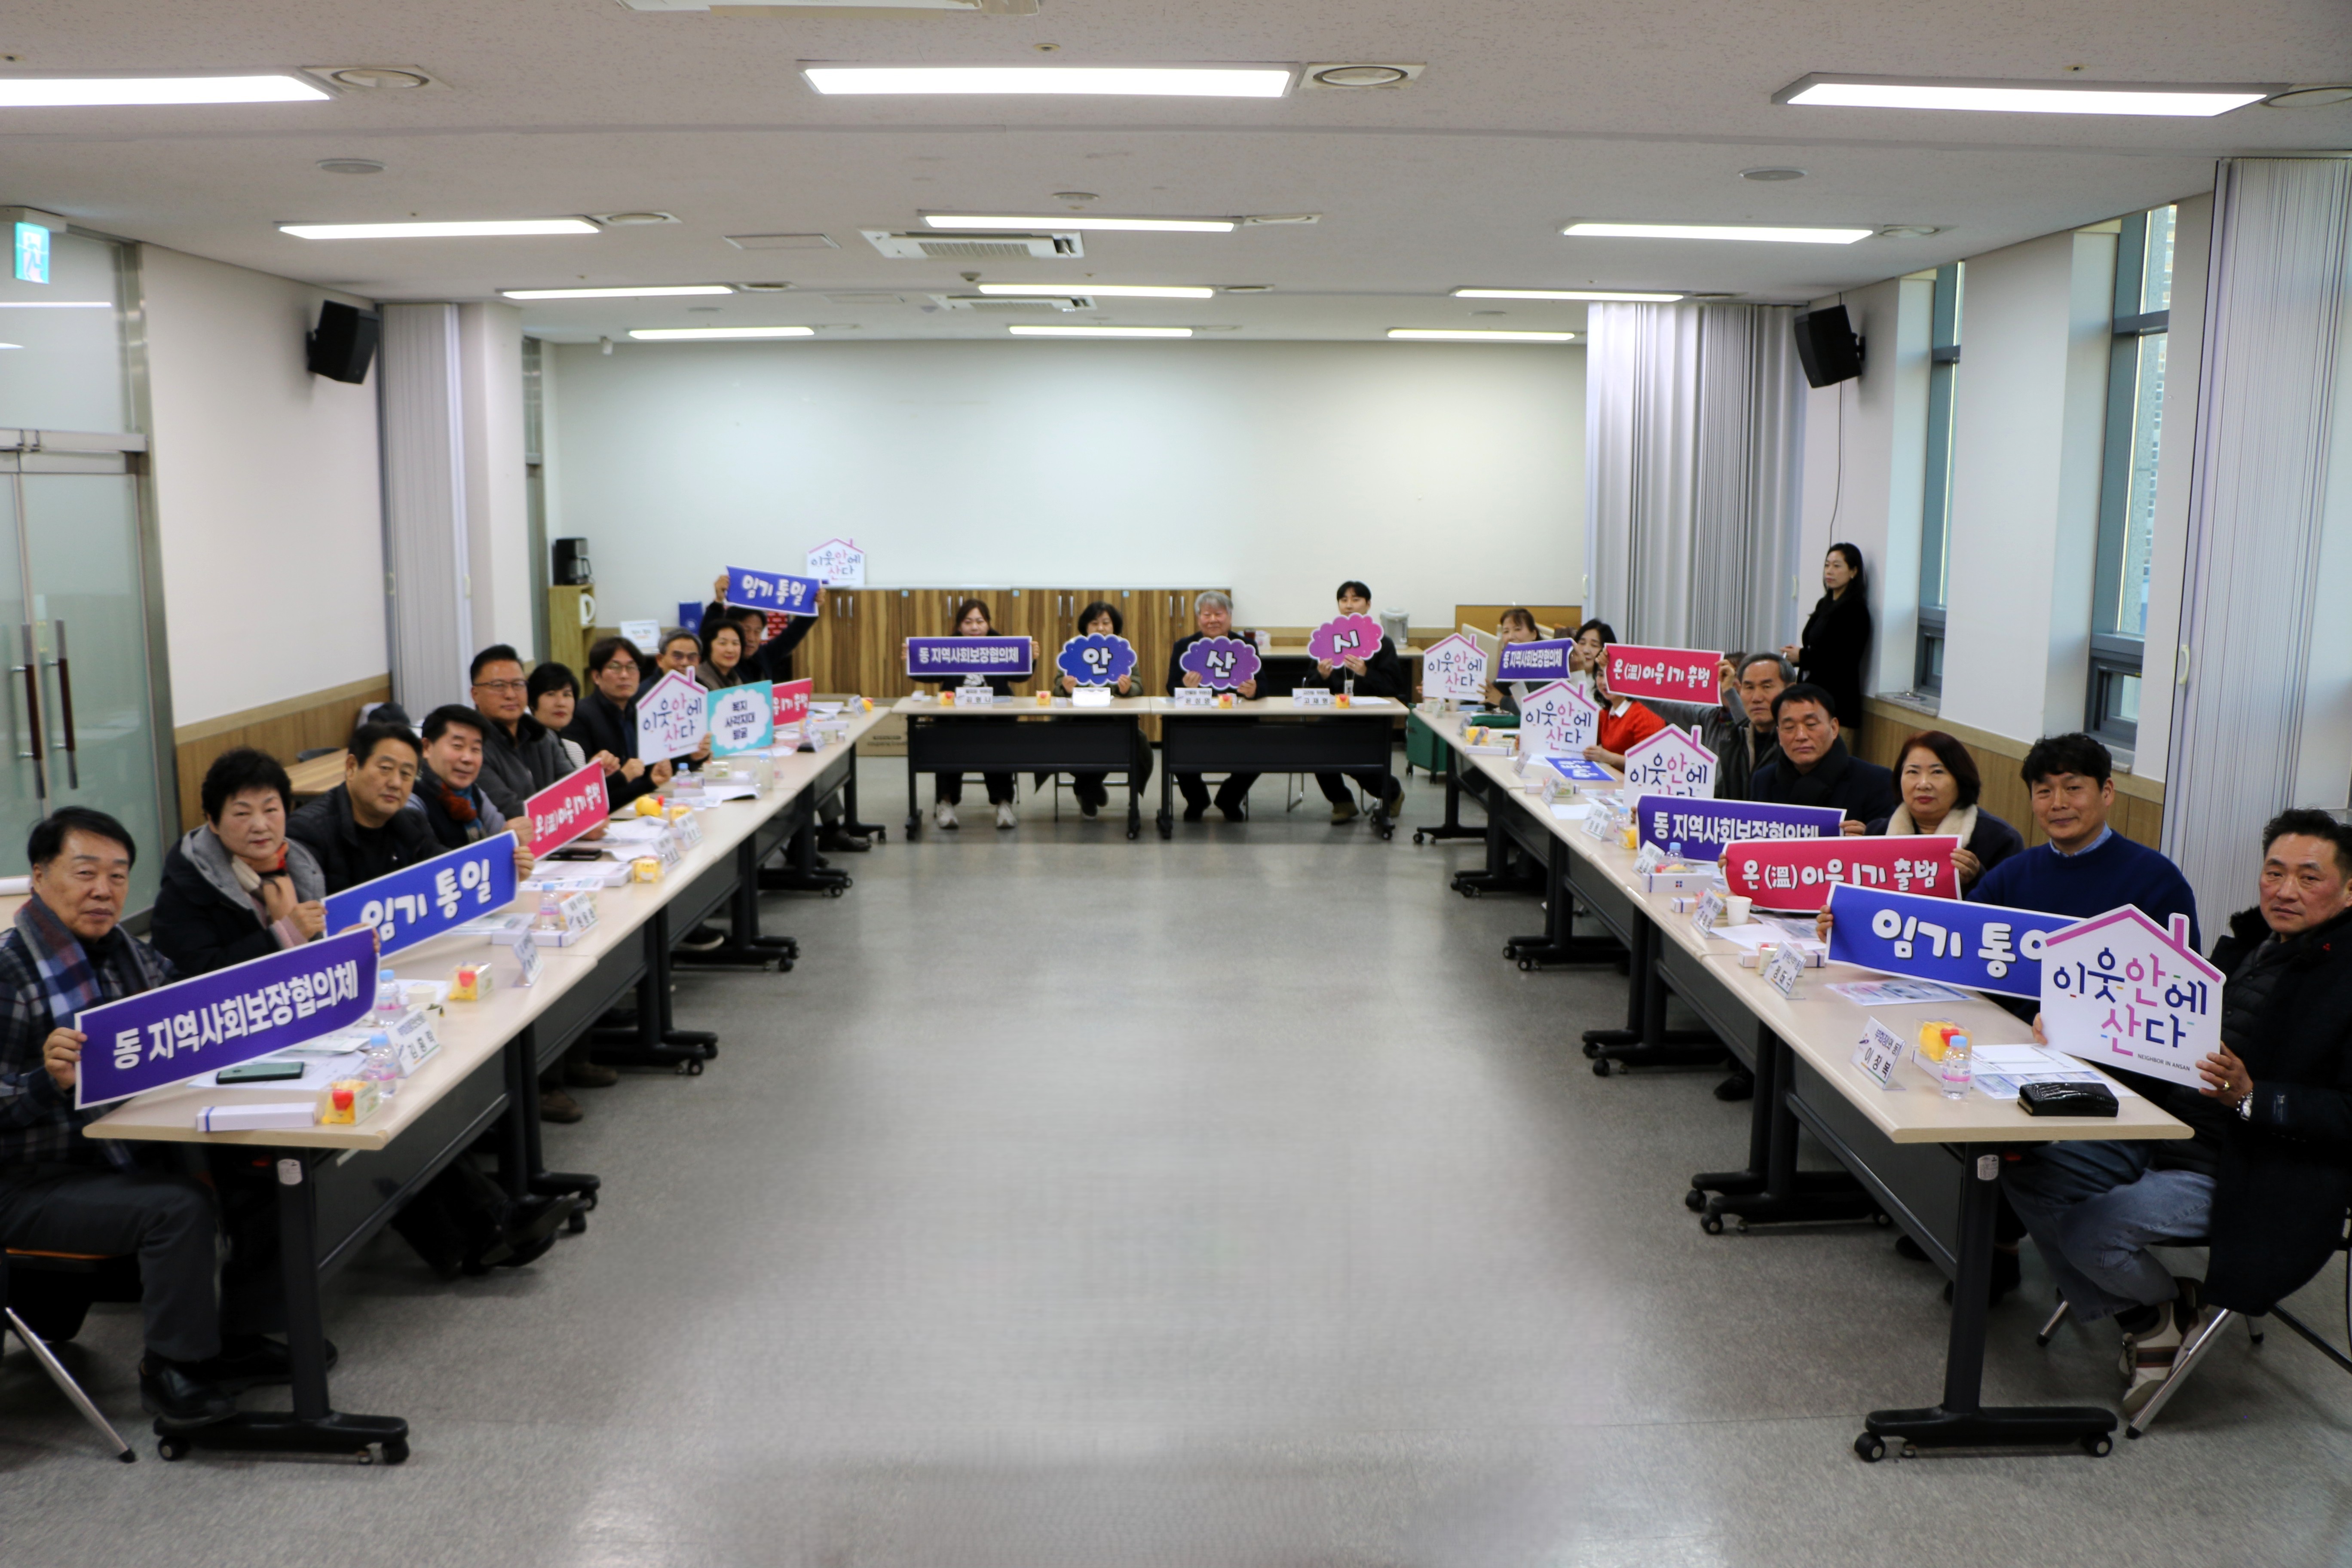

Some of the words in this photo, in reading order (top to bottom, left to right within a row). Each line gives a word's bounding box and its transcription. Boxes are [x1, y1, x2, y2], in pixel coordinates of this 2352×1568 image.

[827, 565, 855, 580] 산다
[742, 575, 773, 599] 임기
[776, 579, 806, 606] 통일
[919, 647, 930, 664] 동
[931, 646, 1019, 664] 지역사회보장협의체
[1333, 630, 1361, 654] 시
[1082, 646, 1113, 675] 안
[1206, 649, 1236, 678] 산
[1503, 651, 1511, 669] 동
[1510, 648, 1563, 668] 지역사회보장협의체
[1446, 672, 1475, 693] 산다
[1666, 666, 1684, 682] 1기
[1687, 665, 1711, 688] 출범
[725, 712, 755, 727] 사각지대
[732, 700, 747, 711] 복지
[665, 720, 695, 752] 산다
[1546, 728, 1582, 750] 산다
[585, 782, 602, 811] 출범
[1654, 811, 1669, 839] 동
[1852, 862, 1886, 885] 1기
[1893, 858, 1938, 891] 출범
[360, 893, 428, 941] 임기
[435, 858, 492, 919] 통일
[1872, 909, 1962, 958] 임기
[1978, 922, 2046, 978] 통
[113, 1028, 142, 1069] 동
[149, 959, 358, 1060] 지역사회보장협의체
[2101, 1004, 2187, 1057] 산다
[2138, 1054, 2164, 1064] NEIGHBOR
[2172, 1062, 2190, 1071] ANSAN
